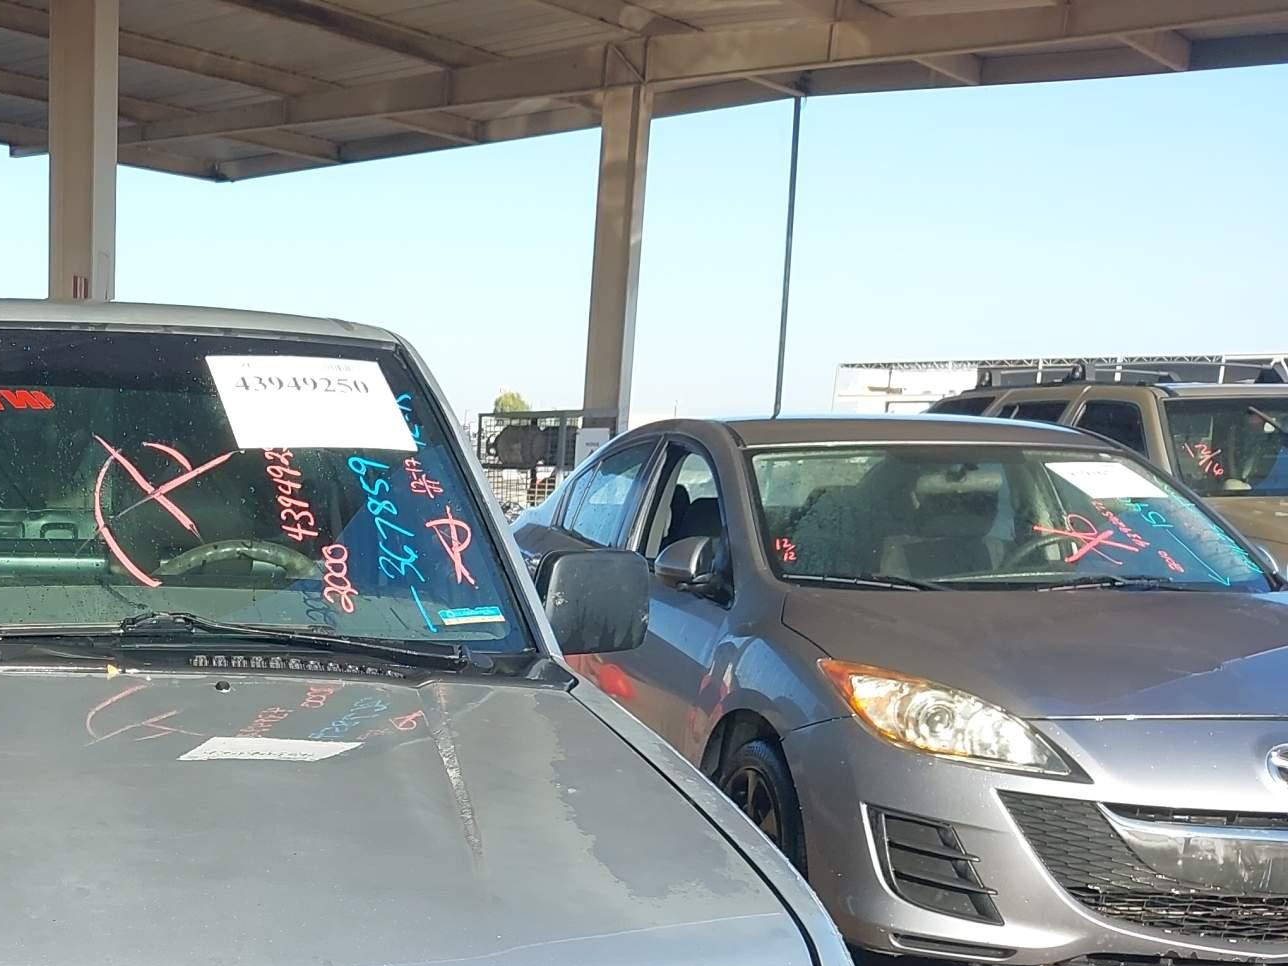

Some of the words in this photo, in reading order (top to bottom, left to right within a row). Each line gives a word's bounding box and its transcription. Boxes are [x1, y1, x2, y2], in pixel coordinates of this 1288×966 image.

[235, 375, 370, 395] 43949250
[347, 456, 425, 583] 367859
[322, 543, 360, 614] 2000
